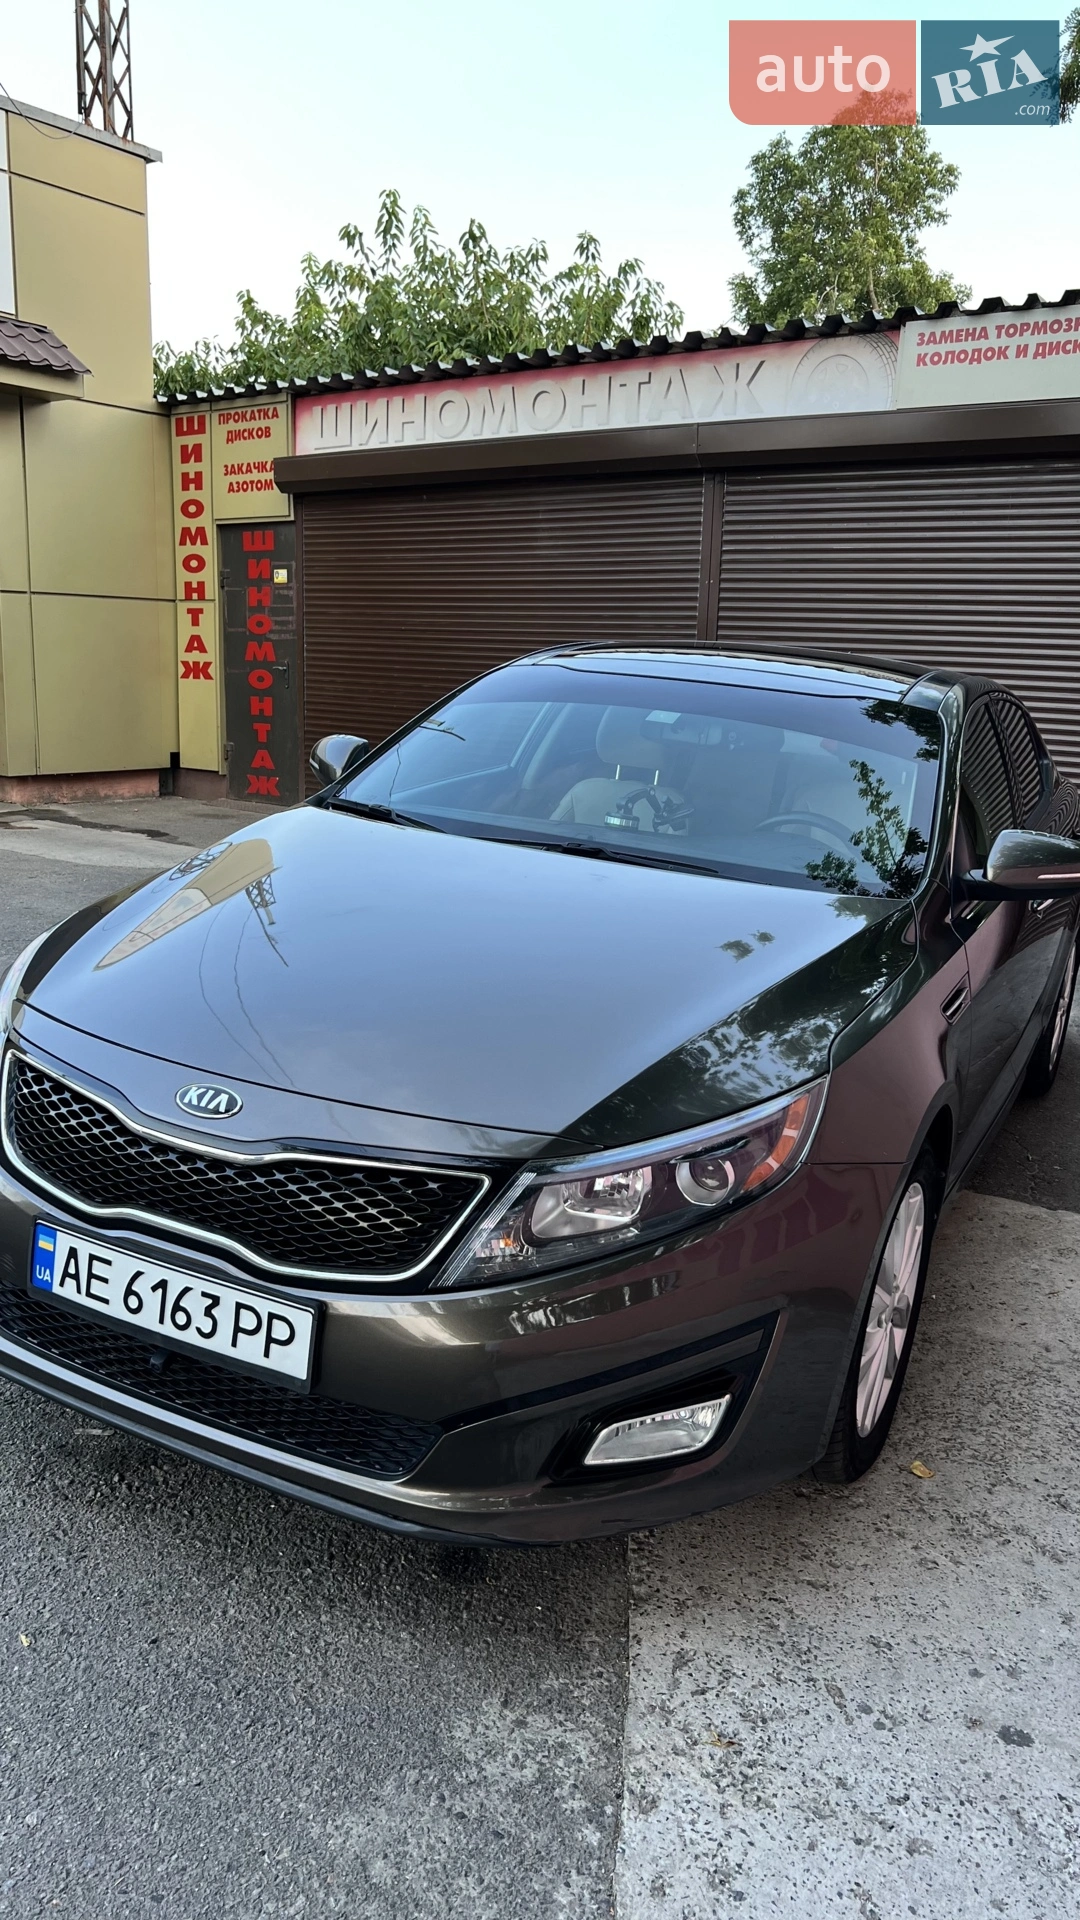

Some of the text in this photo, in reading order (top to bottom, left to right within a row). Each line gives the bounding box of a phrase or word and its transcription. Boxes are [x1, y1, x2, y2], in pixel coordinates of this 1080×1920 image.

[916, 326, 989, 347] ЗАМЕНА
[916, 344, 1010, 367] КОЛОДОК
[1015, 344, 1029, 359] И
[217, 407, 279, 425] ПРОКАТКА
[312, 359, 766, 450] ШИНОМОНТАЖ
[226, 426, 272, 444] ДИСКОВ
[227, 479, 274, 494] АЗОТОМ
[175, 414, 214, 680] ШИНОМОНТАЖ
[242, 530, 281, 797] ШИНОМОНТАЖ
[183, 1086, 230, 1113] KIA
[36, 1268, 52, 1283] UA
[58, 1246, 296, 1359] AE 6163 PP
